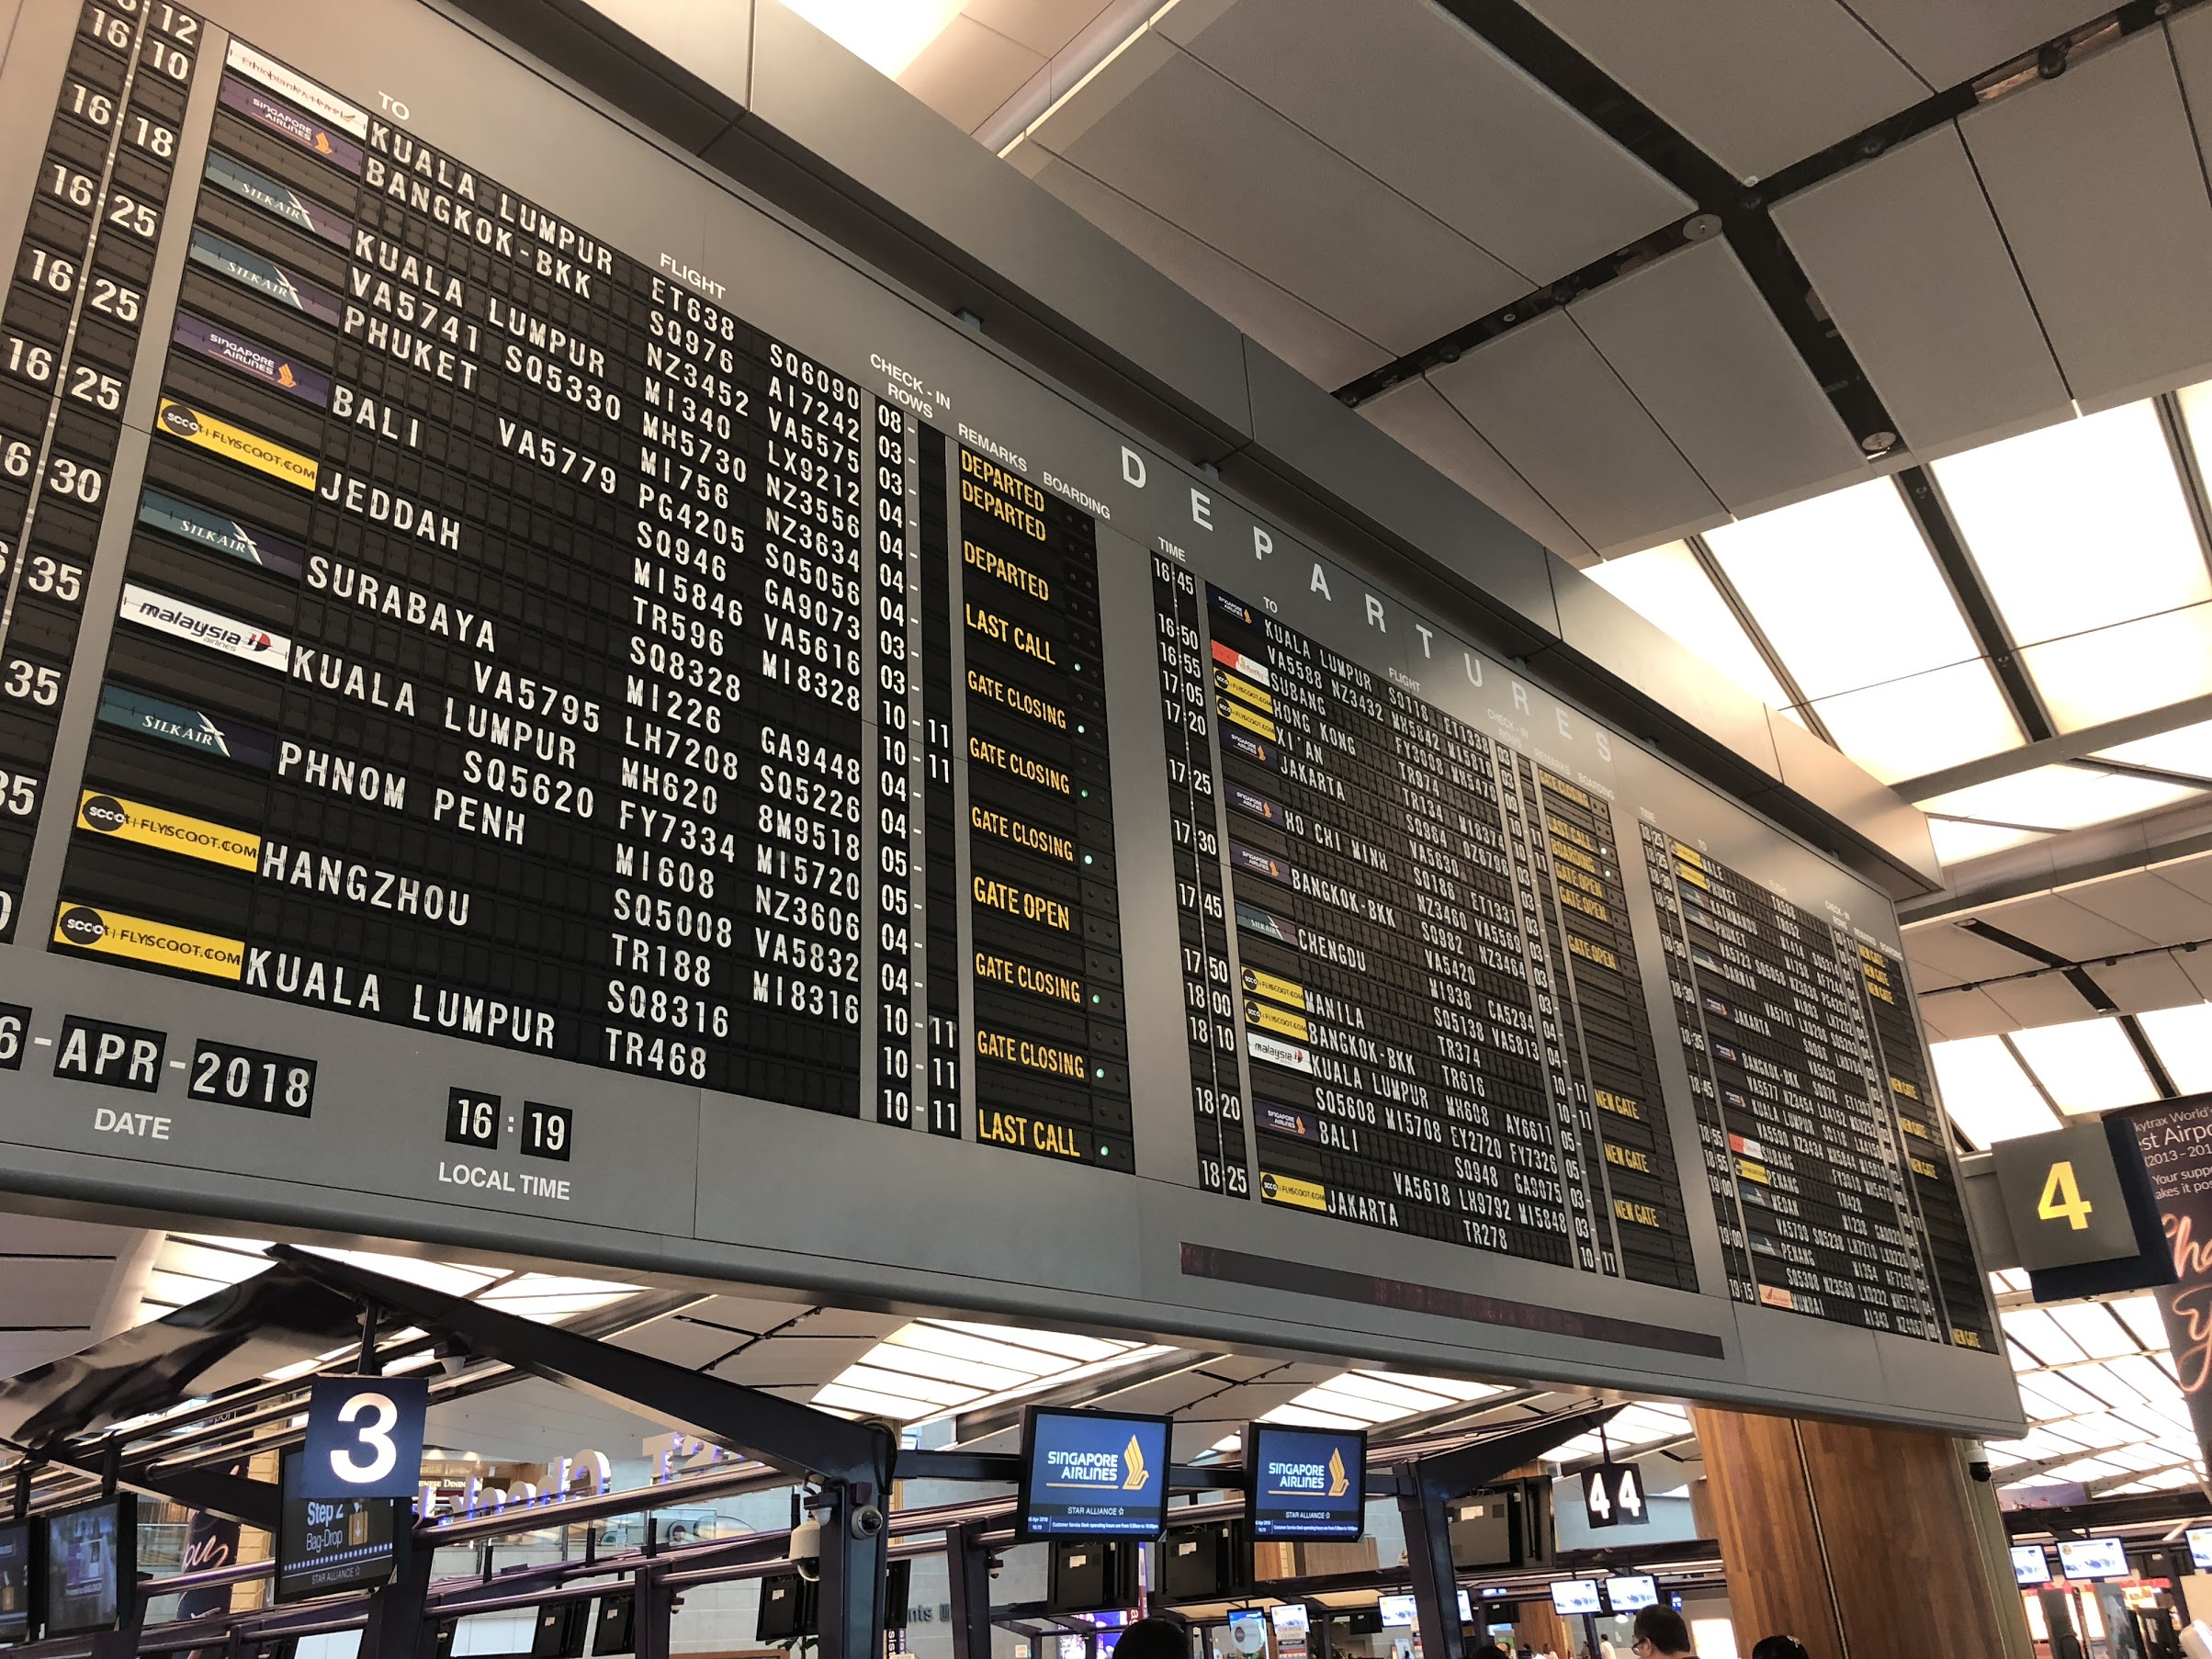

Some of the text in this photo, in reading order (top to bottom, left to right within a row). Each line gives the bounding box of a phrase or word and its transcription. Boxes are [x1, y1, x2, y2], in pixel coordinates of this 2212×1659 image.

[253, 98, 312, 135] SINGAPORE
[265, 113, 311, 141] AIRLINES
[378, 91, 410, 120] TO
[370, 121, 612, 276] KUALA LUMPUR
[366, 157, 591, 299] BANGKOK-BKK
[660, 253, 726, 299] FLIGHT
[352, 266, 476, 352] VA5741
[355, 230, 604, 378] KUALA LUMPUR
[652, 276, 735, 342] ET638
[209, 333, 275, 367] SINGAPORE
[223, 349, 274, 375] AIRLINES
[344, 305, 477, 390] PHUKET
[870, 354, 924, 394] CHECK
[506, 344, 621, 421] SQ5330
[647, 342, 749, 417] NZ3452
[770, 344, 860, 411] SQ6090
[888, 382, 933, 419] ROWS
[333, 384, 418, 447] BALI
[769, 376, 860, 443] AI7242
[499, 417, 616, 494] VA5779
[643, 412, 747, 483] MH5730
[768, 407, 860, 474] VA5575
[958, 423, 1028, 472] REMARKS
[961, 449, 1045, 513] DEPARTED
[1044, 471, 1111, 520] BOARDING
[322, 472, 460, 551] JEDDAH
[638, 483, 744, 553] PG4205
[637, 521, 727, 581] SQ946
[765, 541, 860, 607] SQ5056
[964, 540, 1049, 602] DEPARTED
[1158, 536, 1186, 562] TIME
[307, 555, 495, 653] SURABAYA
[634, 557, 743, 626] MI5846
[1263, 596, 1278, 614] TO
[140, 602, 241, 645] malaysia
[965, 604, 1056, 666] LAST CALL
[1265, 618, 1372, 693] KUALA LUMPUR
[1267, 645, 1323, 690] VA5588
[1389, 667, 1420, 694] FLIGHT
[292, 645, 576, 770] KUALA LUMPUR
[473, 660, 601, 733] VA5795
[626, 674, 721, 734] MI226
[967, 671, 1066, 729] GATE CLOSING
[1270, 672, 1326, 717] SUBANG
[1273, 699, 1356, 756] HONG KONG
[277, 741, 525, 845] PHNOM PENH
[463, 750, 594, 818] SQ5620
[1281, 756, 1346, 802] JAKARTA
[619, 800, 735, 863] FY7334
[759, 805, 860, 862] 8M9518
[1284, 809, 1304, 836] HO
[1315, 823, 1341, 852] CHI
[263, 841, 469, 926] HANGZHOU
[974, 875, 1069, 931] GATE OPEN
[1298, 928, 1366, 972] CHENGDU
[246, 947, 555, 1049] KUALA LUMPUR
[607, 980, 728, 1038] SQ8316
[753, 970, 859, 1024] MI8316
[1304, 989, 1365, 1031] MANILA
[605, 1027, 706, 1080] TR468
[1308, 1021, 1416, 1076] BANGKOK-BKK
[95, 1108, 172, 1140] DATE
[1594, 1088, 1640, 1120] NEW GATE
[2134, 1117, 2168, 1132] kytrax
[979, 1109, 1080, 1157] LAST CALL
[1319, 1121, 1359, 1152] BALI
[2139, 1133, 2160, 1150] st
[438, 1161, 570, 1201] LOCAL TIME
[2038, 1161, 2093, 1230] 4
[2152, 1172, 2178, 1185] Your
[2156, 1187, 2180, 1200] akes
[2181, 1183, 2191, 1193] it
[1328, 1190, 1399, 1227] JAKARTA
[330, 1393, 398, 1484] 3
[1047, 1450, 1119, 1467] SINGAPORE
[1061, 1466, 1118, 1482] AIRLINES
[1269, 1462, 1325, 1476] SINGAPORE
[1280, 1476, 1325, 1488] AIRLINES
[1589, 1471, 1641, 1519] 44
[308, 1501, 333, 1527] Step
[1086, 1507, 1117, 1516] ALLIANCE
[306, 1529, 343, 1552] Bag-Drop
